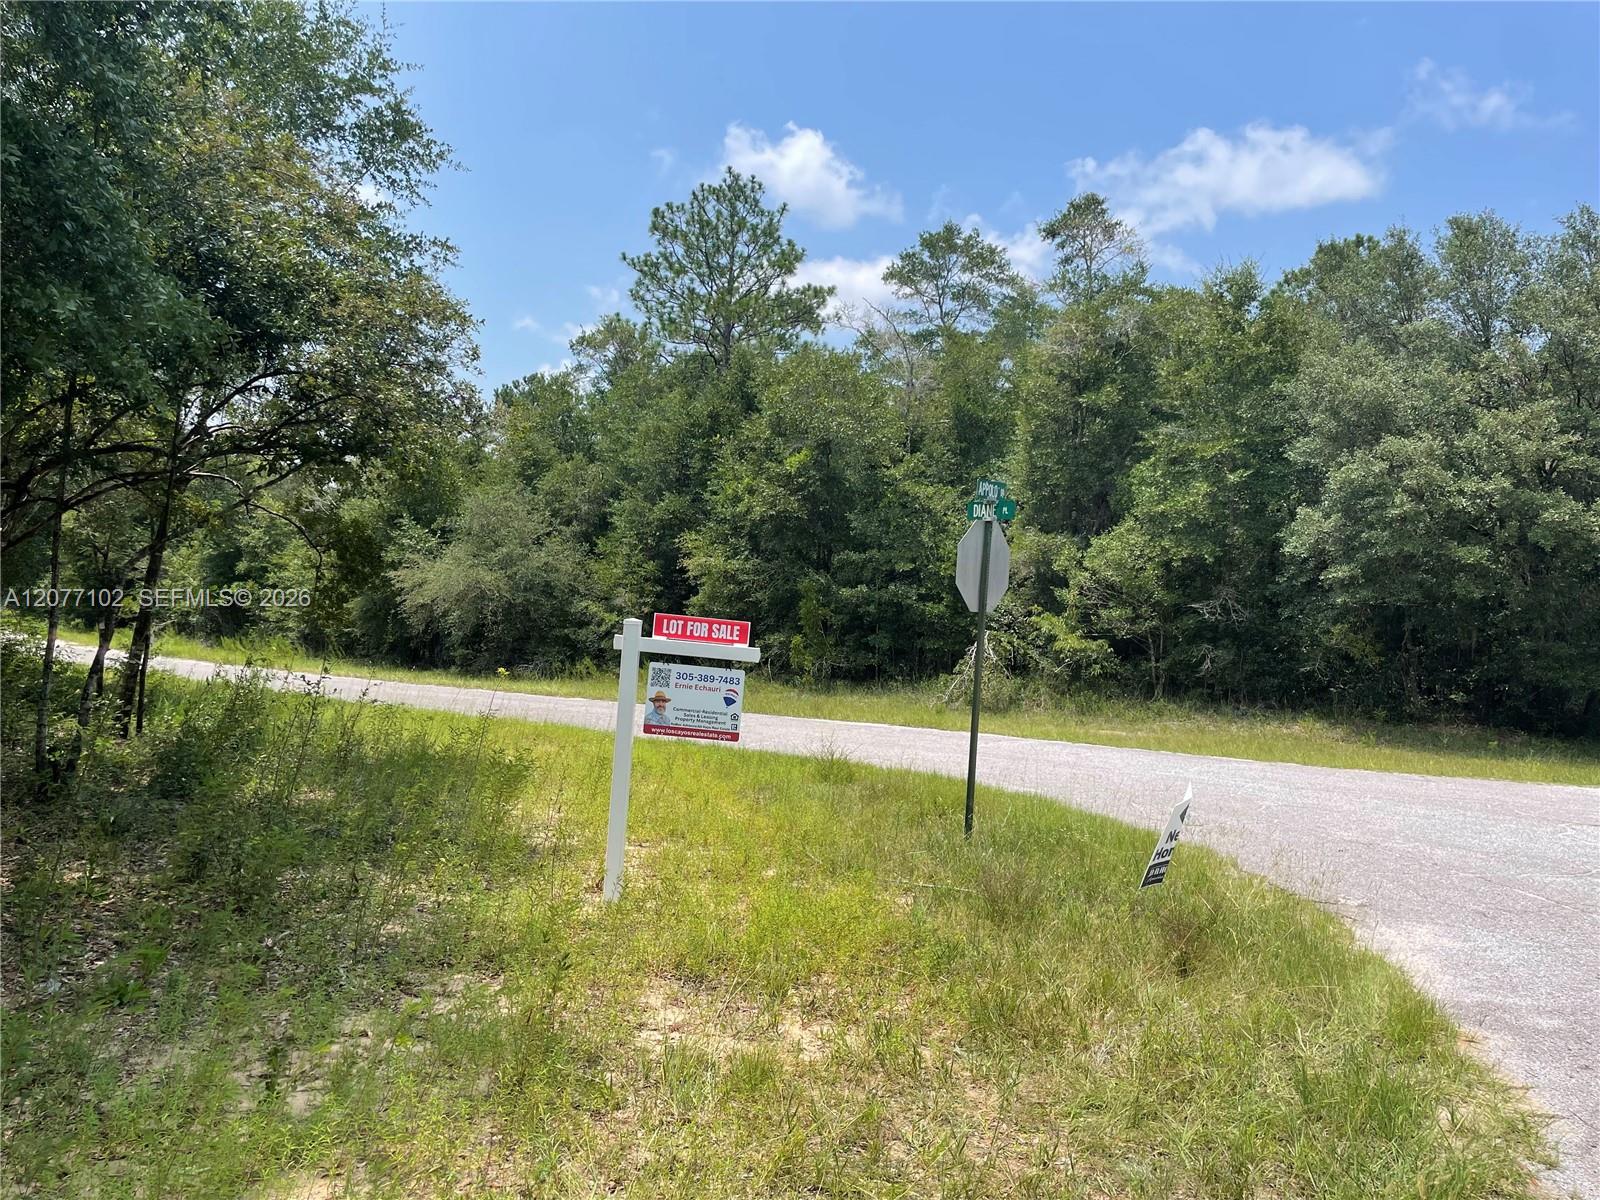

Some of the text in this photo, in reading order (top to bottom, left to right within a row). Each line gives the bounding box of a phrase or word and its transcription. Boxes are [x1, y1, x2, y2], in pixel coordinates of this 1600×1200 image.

[973, 504, 996, 518] DIANE
[662, 618, 740, 640] LOT FOR SALE
[675, 671, 741, 686] 305-389-7483
[674, 682, 721, 693] Ernie Echauri
[674, 716, 727, 726] Property Management
[651, 726, 732, 740] www.loscayosrealestate.com
